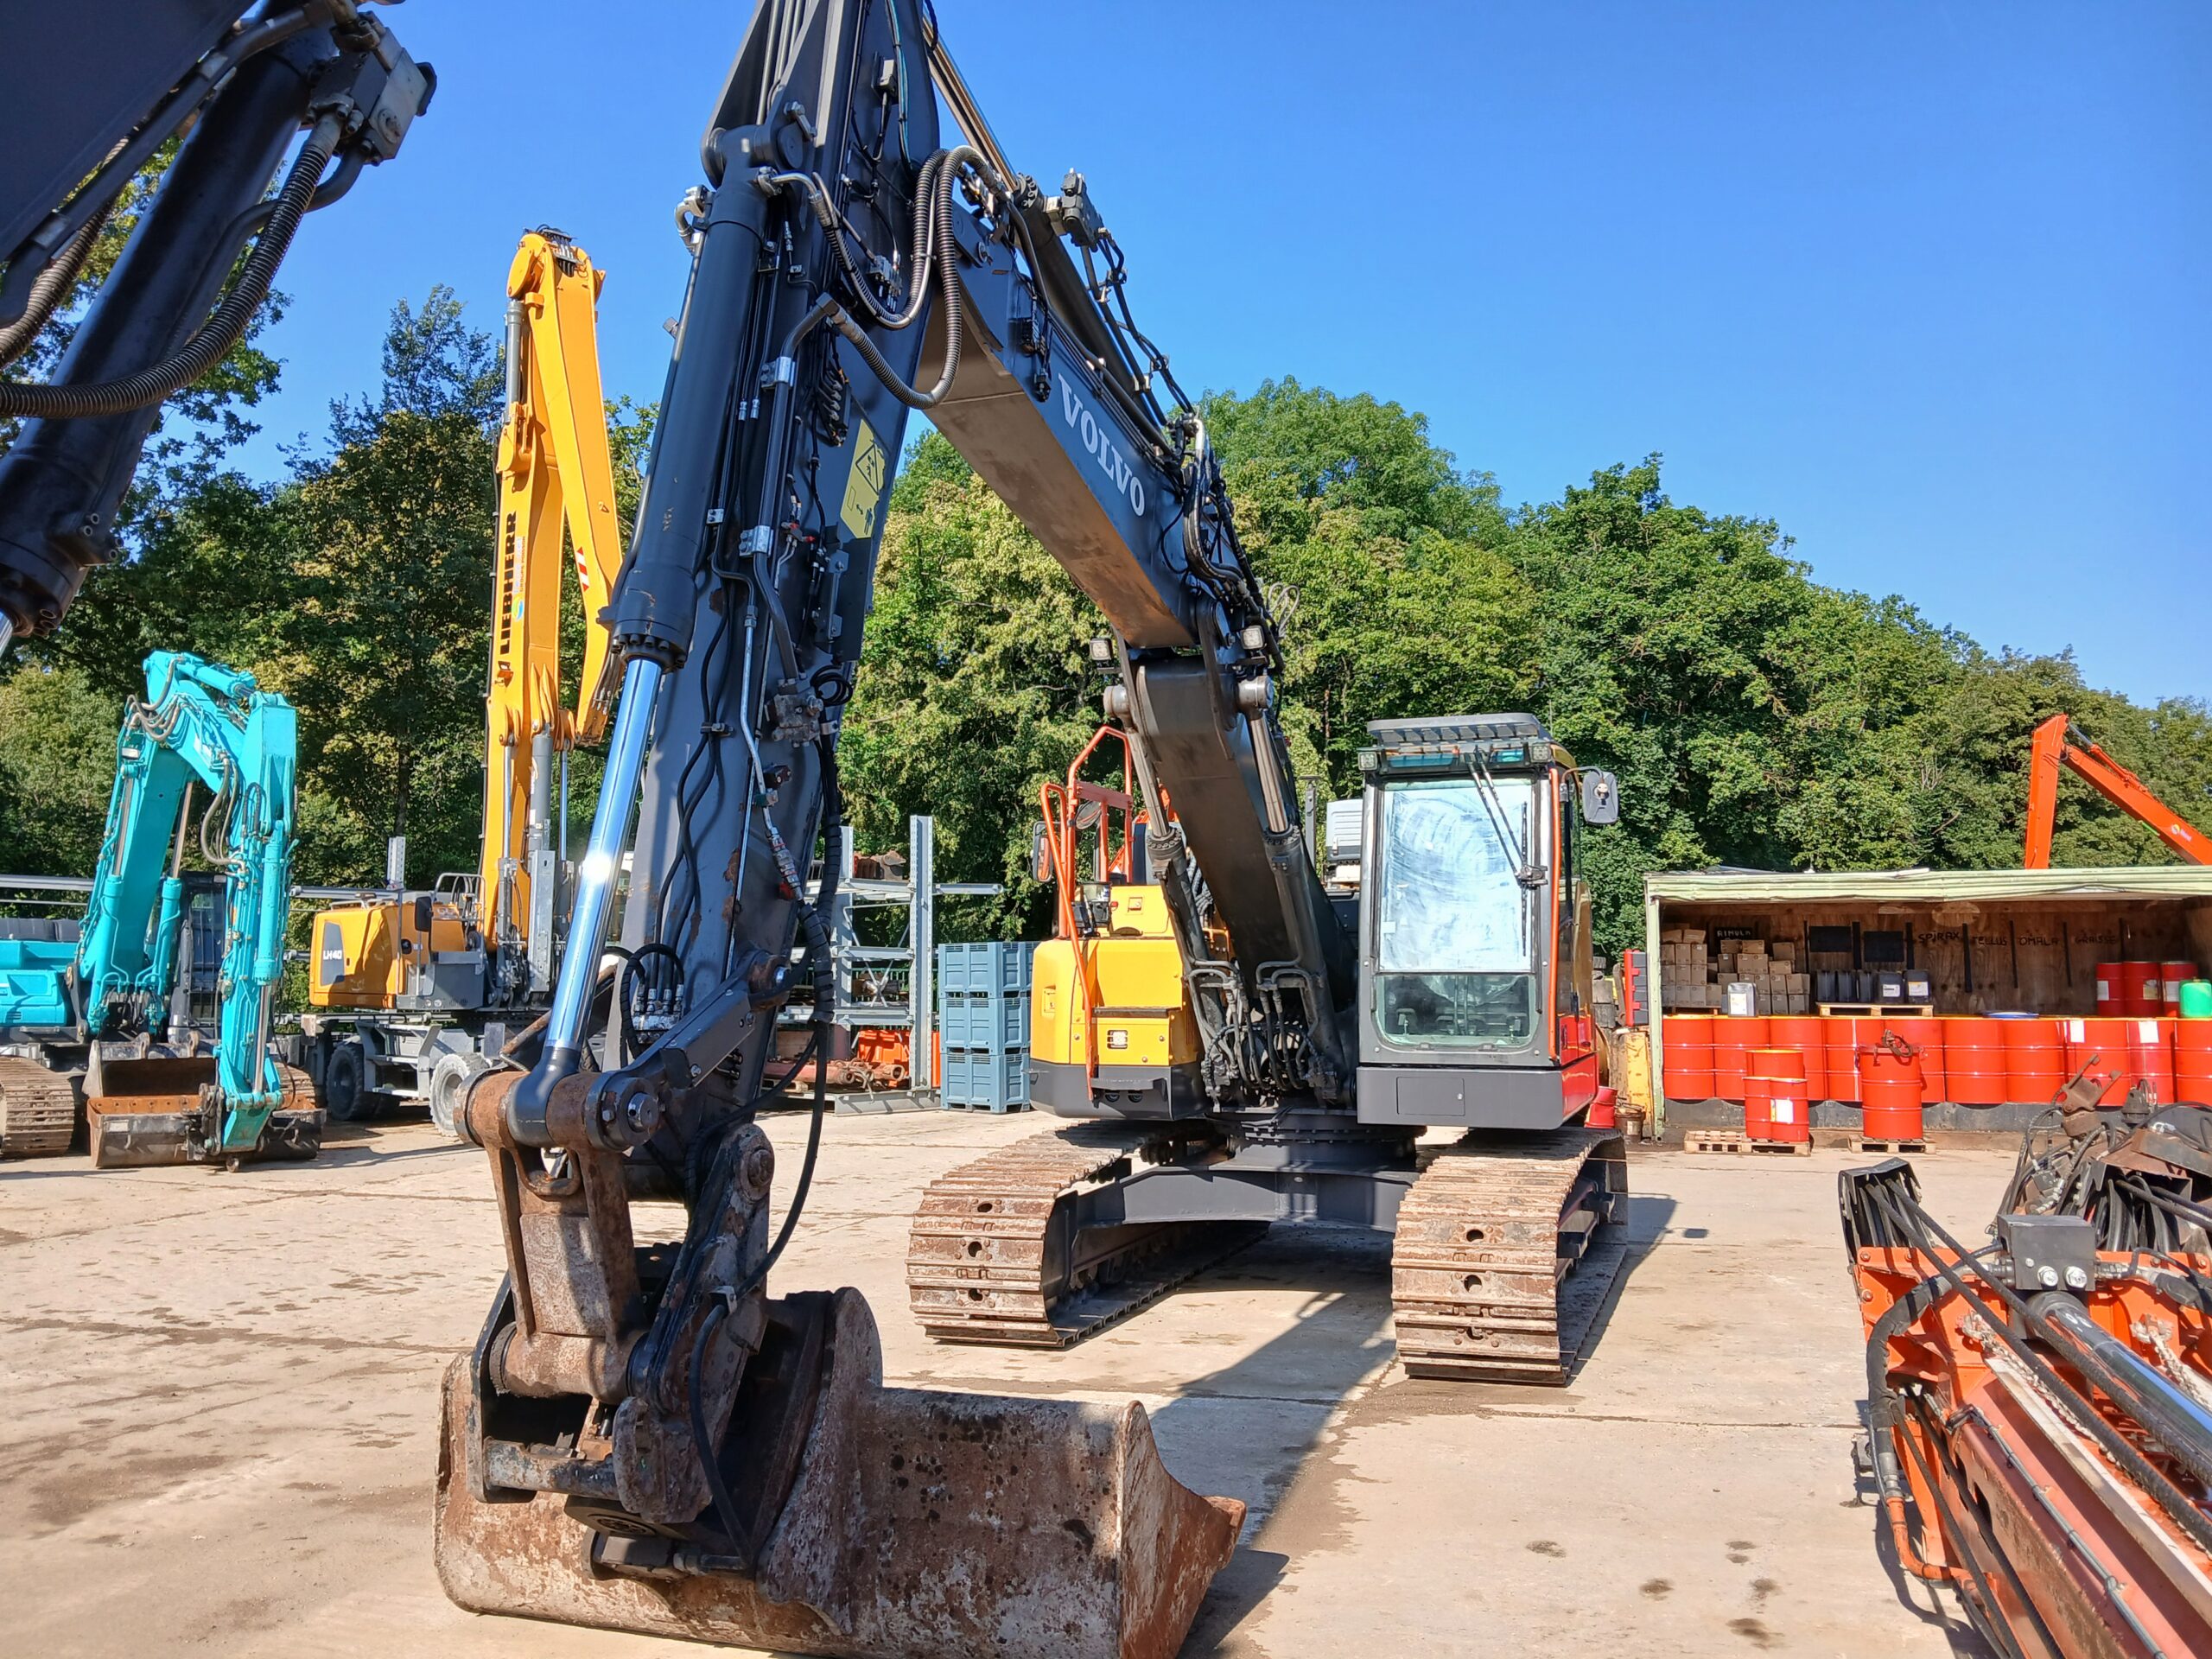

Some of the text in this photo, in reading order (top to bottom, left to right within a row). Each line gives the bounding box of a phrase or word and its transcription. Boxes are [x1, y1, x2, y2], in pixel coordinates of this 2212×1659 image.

[1058, 373, 1145, 517] VOLVO
[499, 512, 517, 655] LIEBHERR
[2019, 936, 2060, 946] OMALA
[2075, 935, 2117, 944] GRAISSE
[323, 950, 342, 960] LH40
